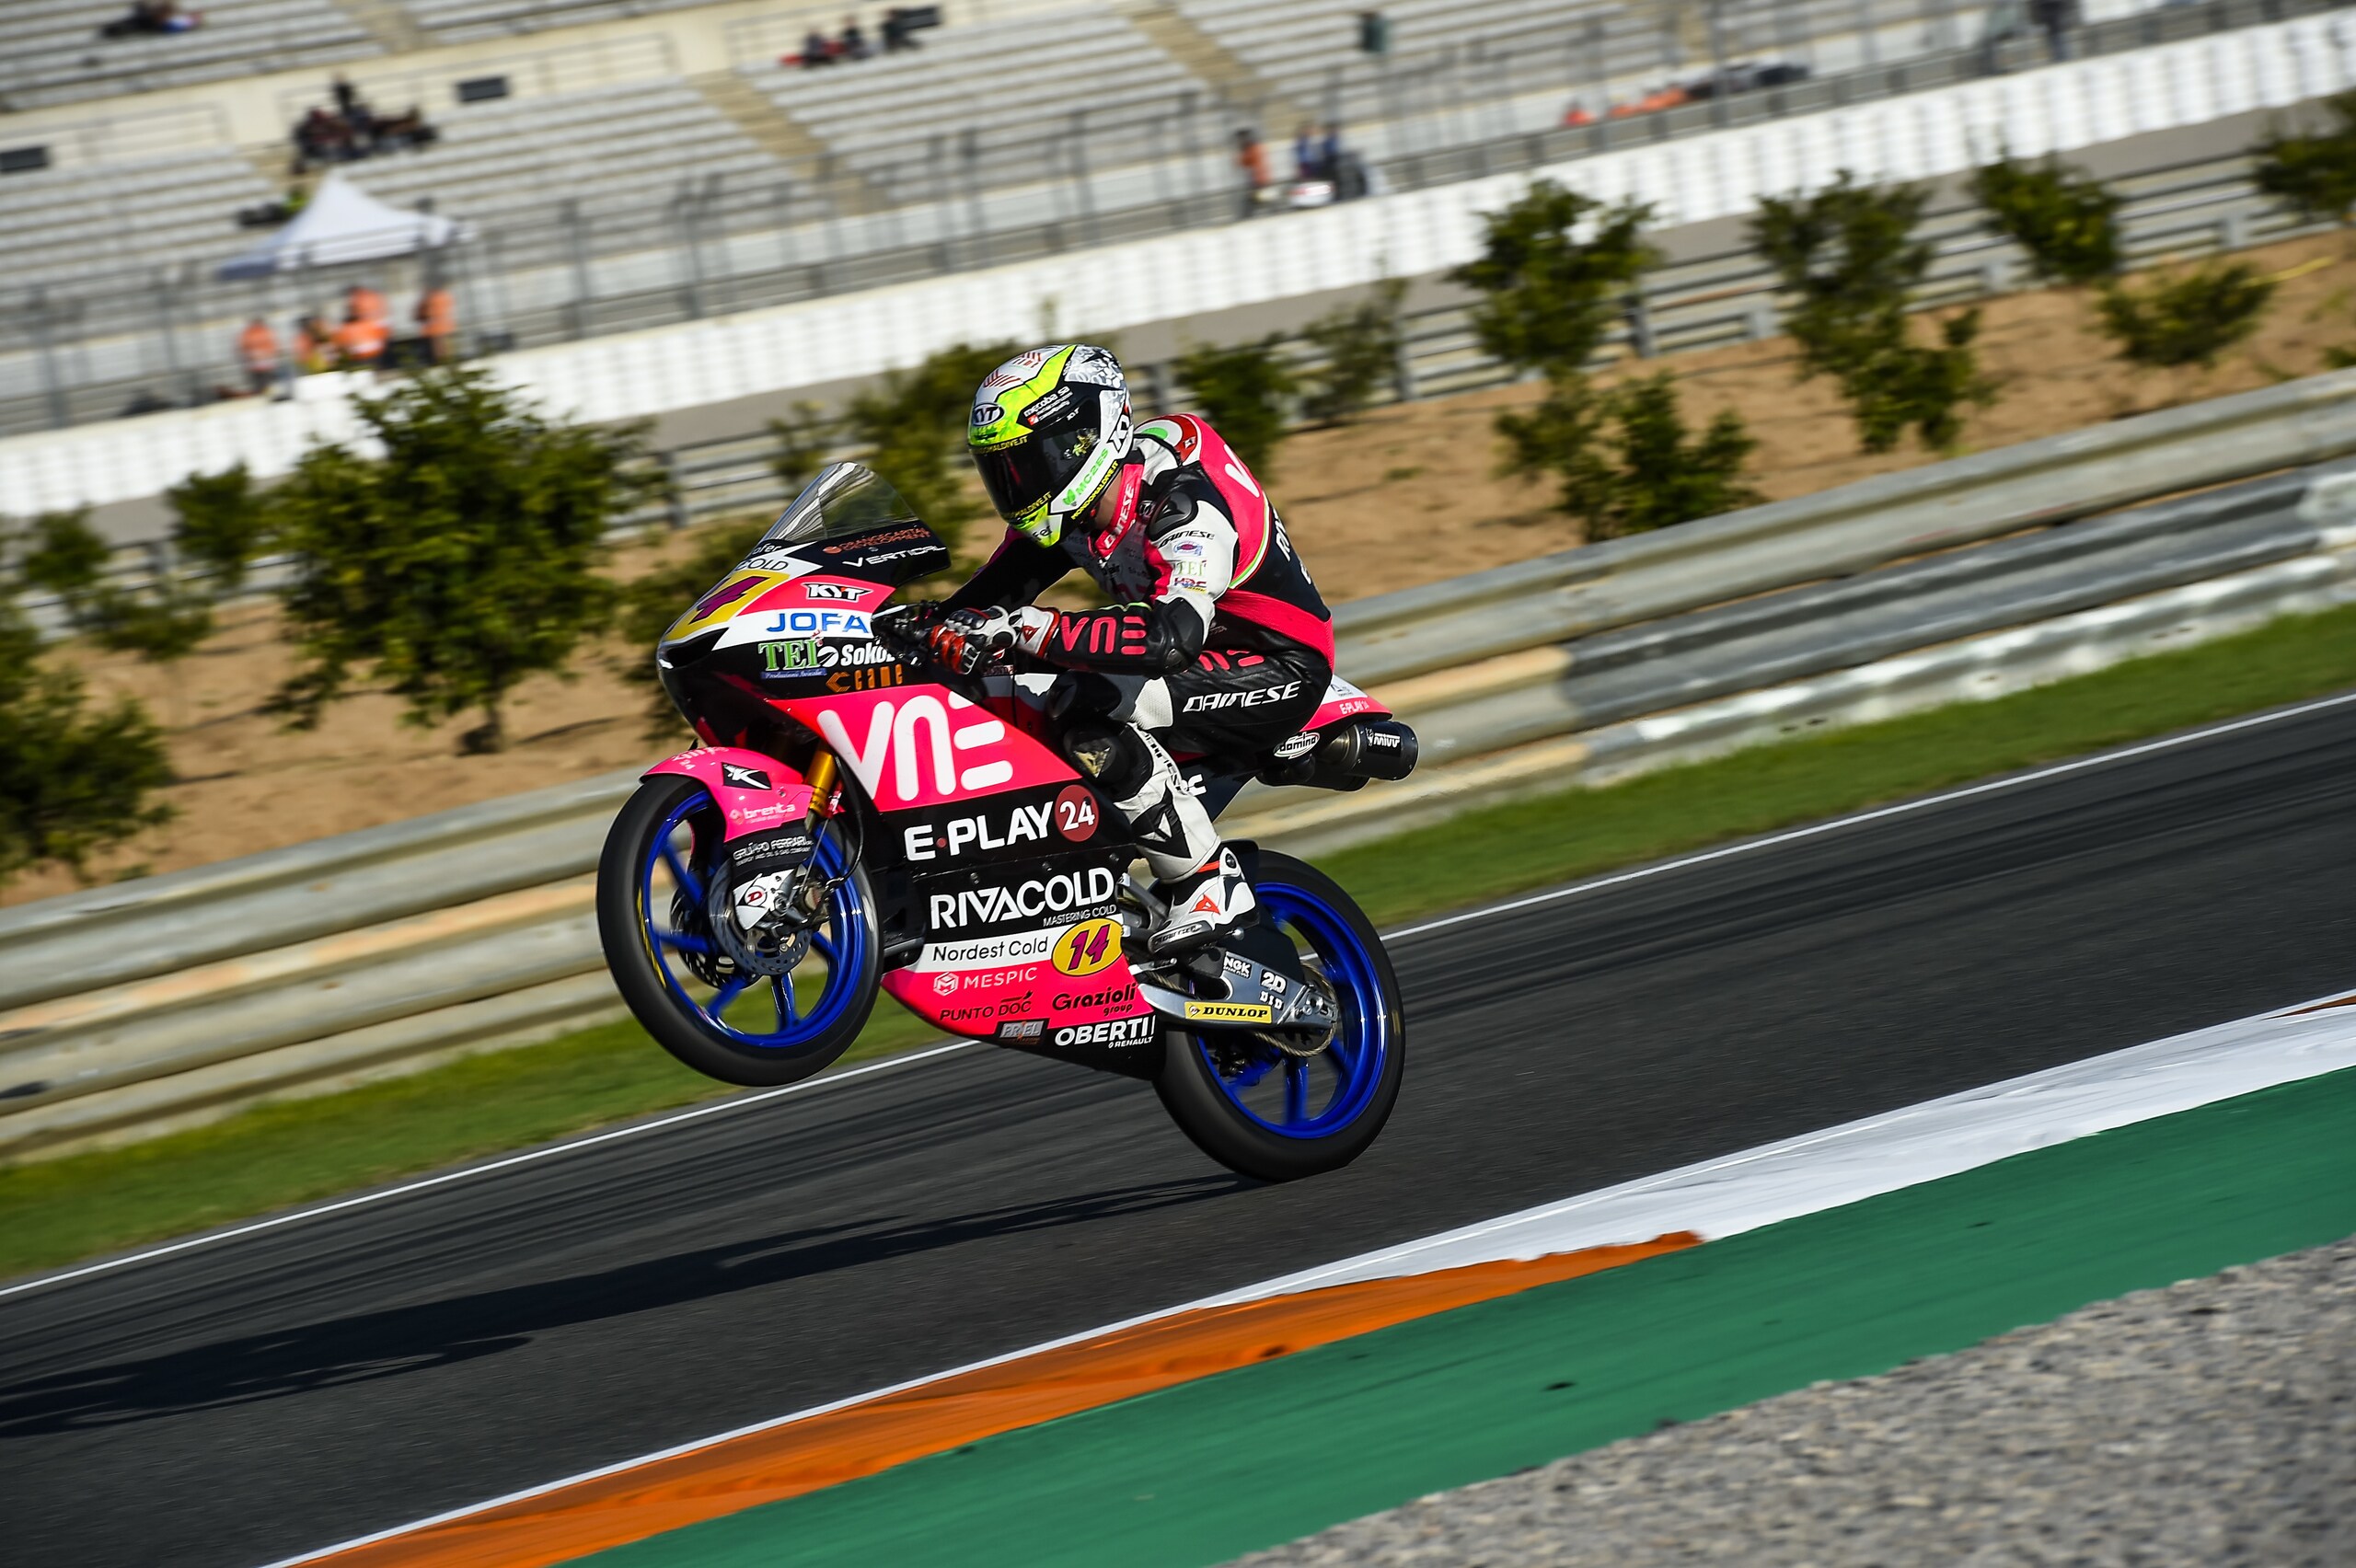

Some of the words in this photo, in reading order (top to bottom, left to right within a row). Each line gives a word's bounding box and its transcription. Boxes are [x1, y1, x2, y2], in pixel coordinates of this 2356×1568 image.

[1160, 529, 1216, 548] DAINESE
[841, 545, 947, 568] VERTICAL
[807, 582, 867, 601] KYT
[766, 612, 871, 634] JOFA
[757, 638, 822, 672] TEI
[1182, 680, 1302, 713] DAINESE
[1279, 732, 1317, 753] domino
[743, 801, 796, 820] brenta
[1058, 801, 1096, 832] 24
[930, 867, 1114, 929] RIVACOLD
[1043, 908, 1091, 928] MASTERING
[1091, 904, 1117, 919] COLD
[932, 940, 1007, 962] Nordest
[1008, 936, 1048, 957] Cold
[1067, 923, 1111, 971] 14
[1223, 956, 1251, 974] NGK
[964, 967, 1038, 990] MESPIC
[1261, 971, 1287, 994] 2D
[1052, 982, 1138, 1011] Grazioli
[939, 1006, 995, 1021] PUNTO
[998, 1000, 1032, 1016] DOC
[1103, 1003, 1134, 1016] group
[1203, 1007, 1268, 1018] DUNLOP
[1055, 1016, 1149, 1046] OBERTI
[1114, 1036, 1153, 1048] RENAULT
